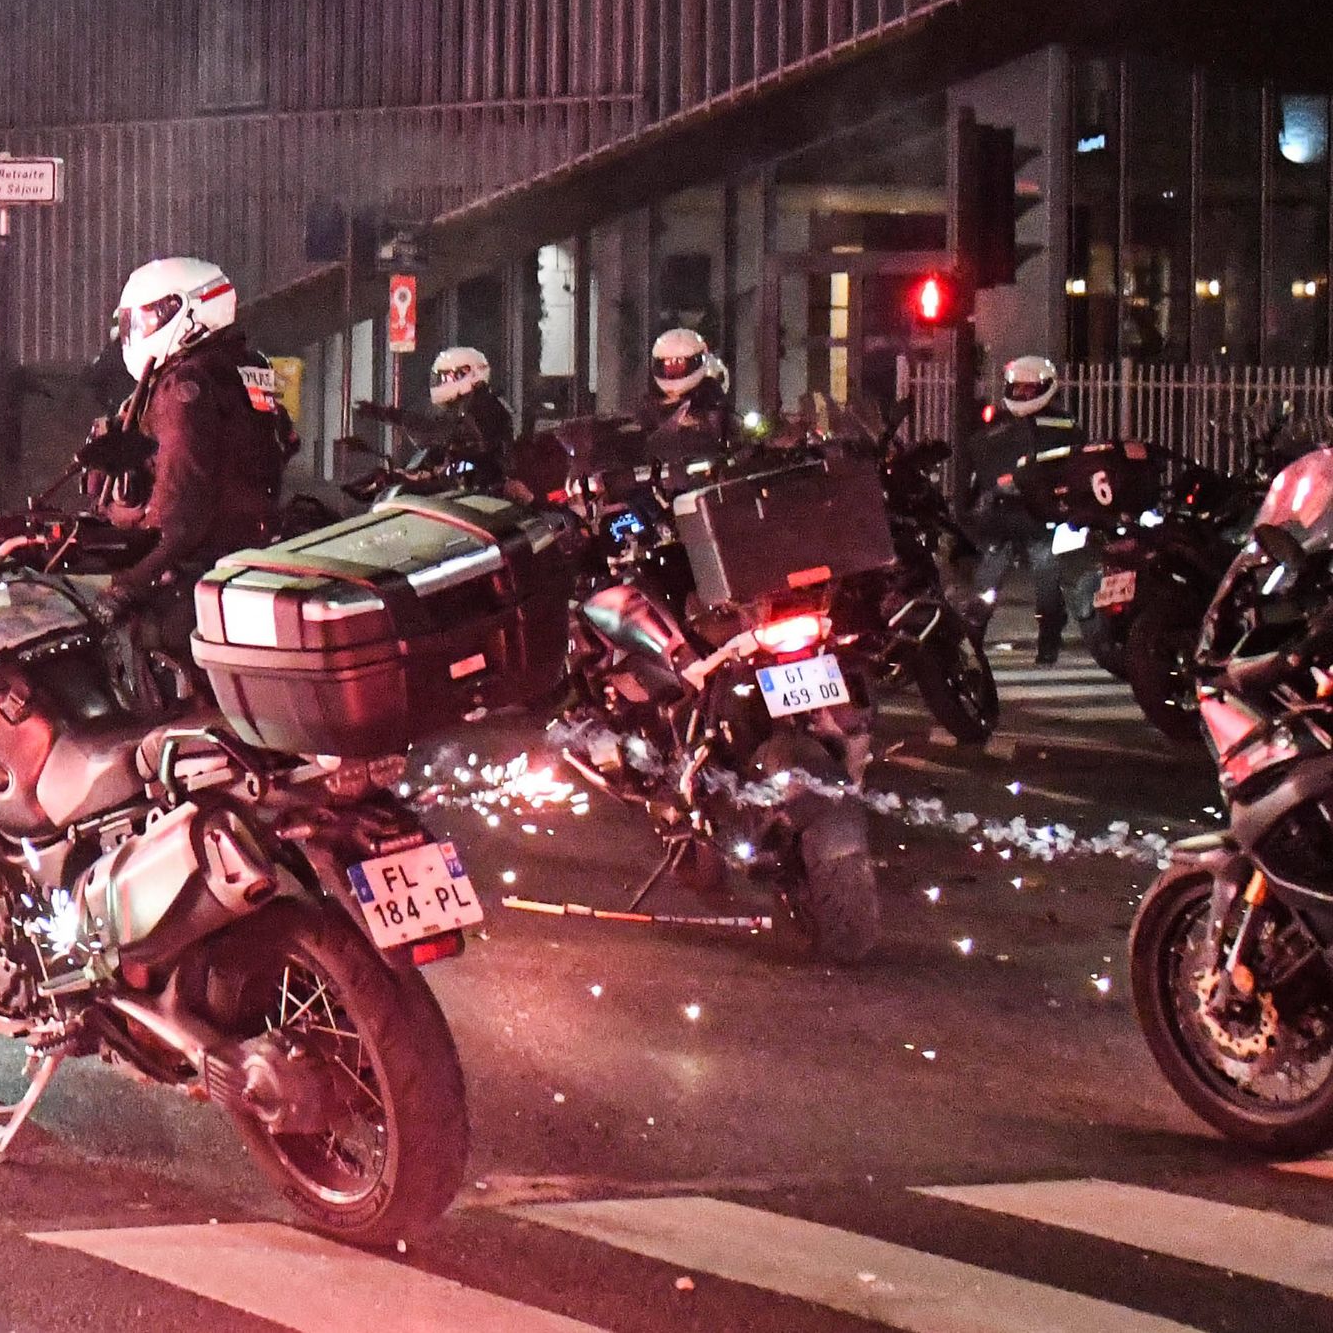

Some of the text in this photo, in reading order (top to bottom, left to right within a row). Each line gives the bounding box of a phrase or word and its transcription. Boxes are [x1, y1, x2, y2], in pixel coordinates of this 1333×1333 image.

[7, 184, 44, 197] Séjour
[1091, 470, 1113, 506] 6
[784, 666, 804, 684] GT
[381, 864, 419, 893] FL
